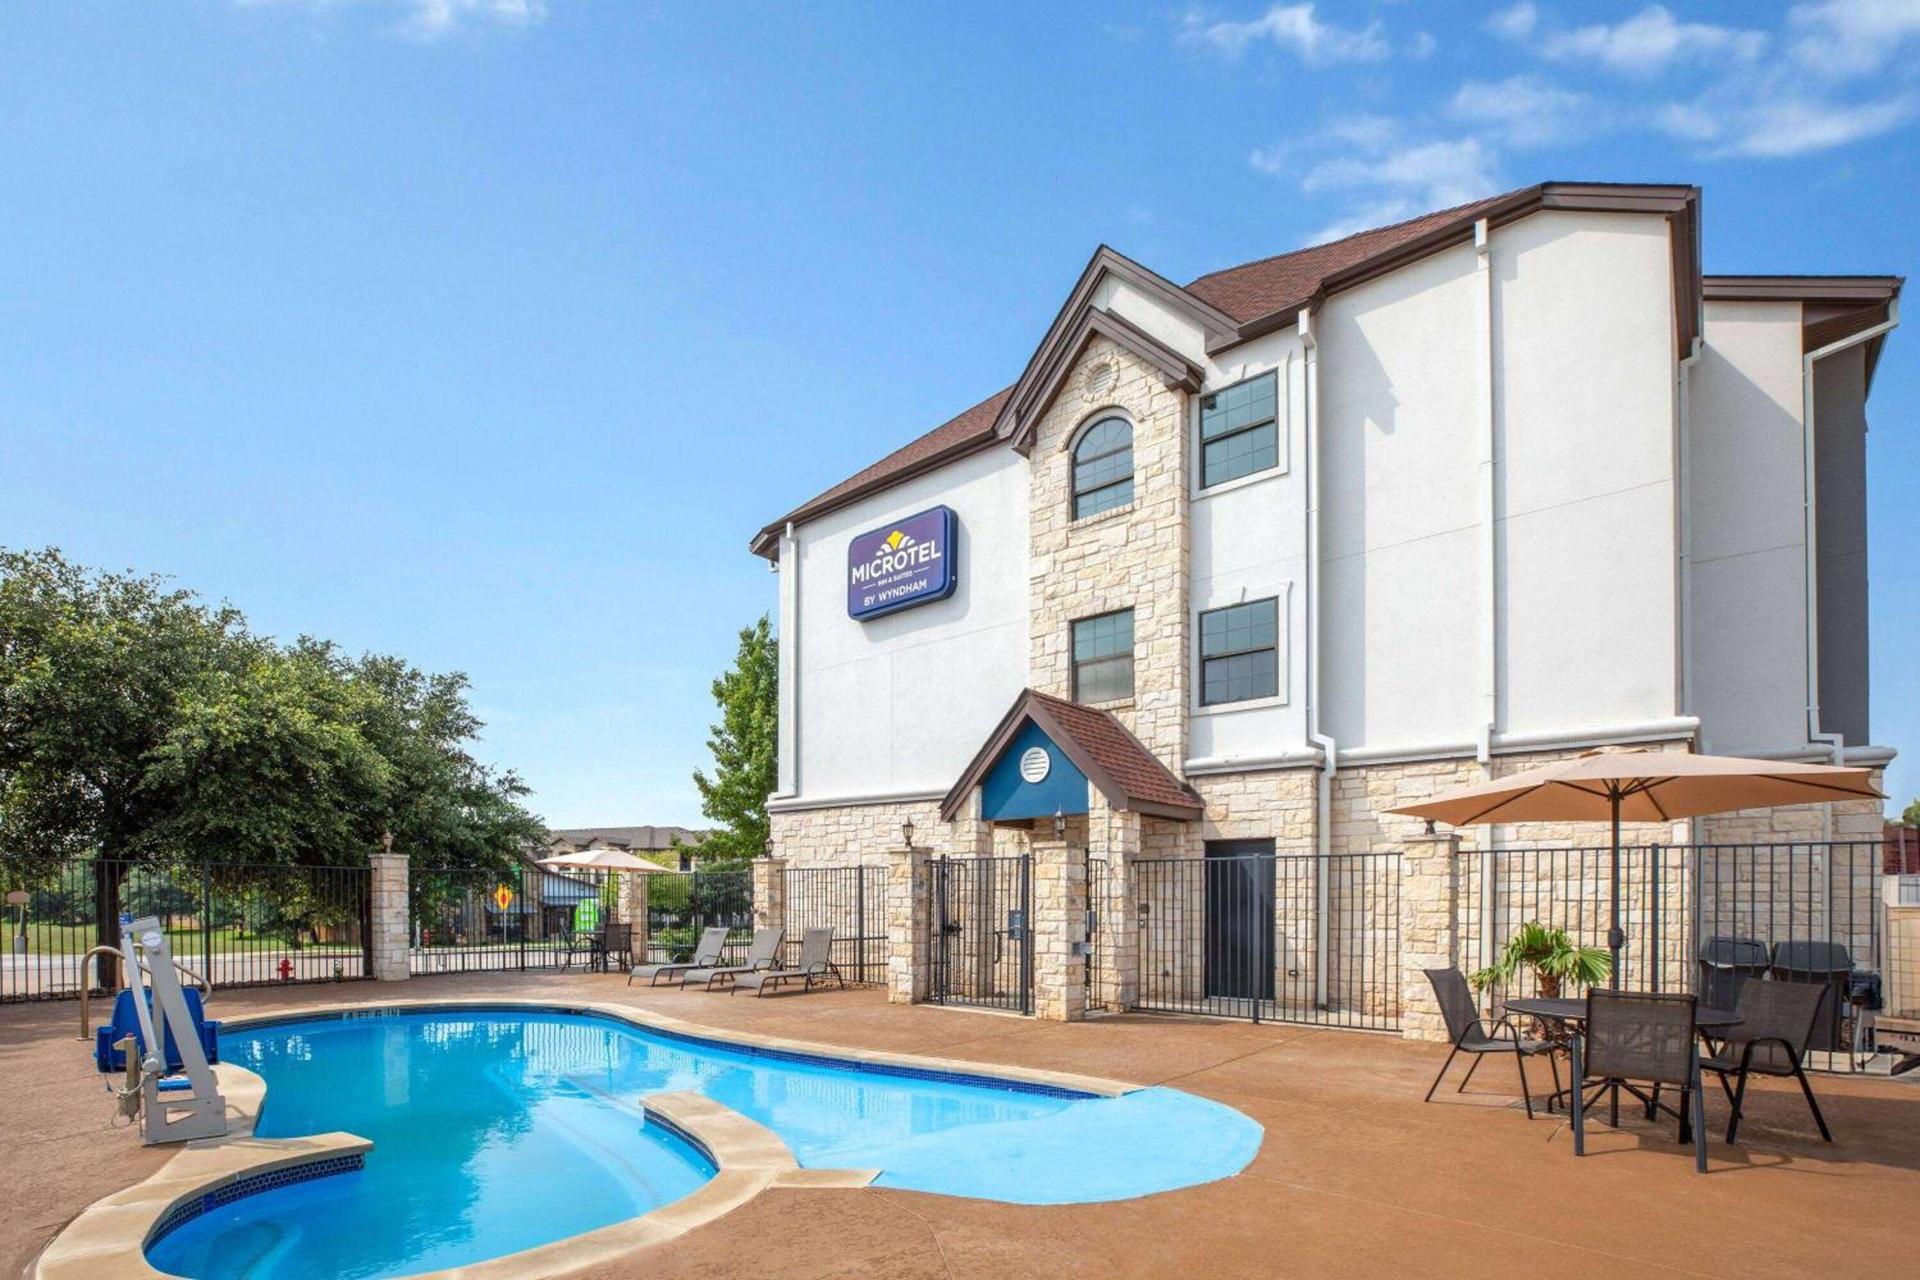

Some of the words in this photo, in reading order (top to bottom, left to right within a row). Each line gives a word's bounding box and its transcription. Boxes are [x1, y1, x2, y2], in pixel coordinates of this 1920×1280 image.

[852, 540, 941, 584] MICROTEL
[864, 594, 876, 606] BY
[879, 579, 927, 601] WYNDHAM
